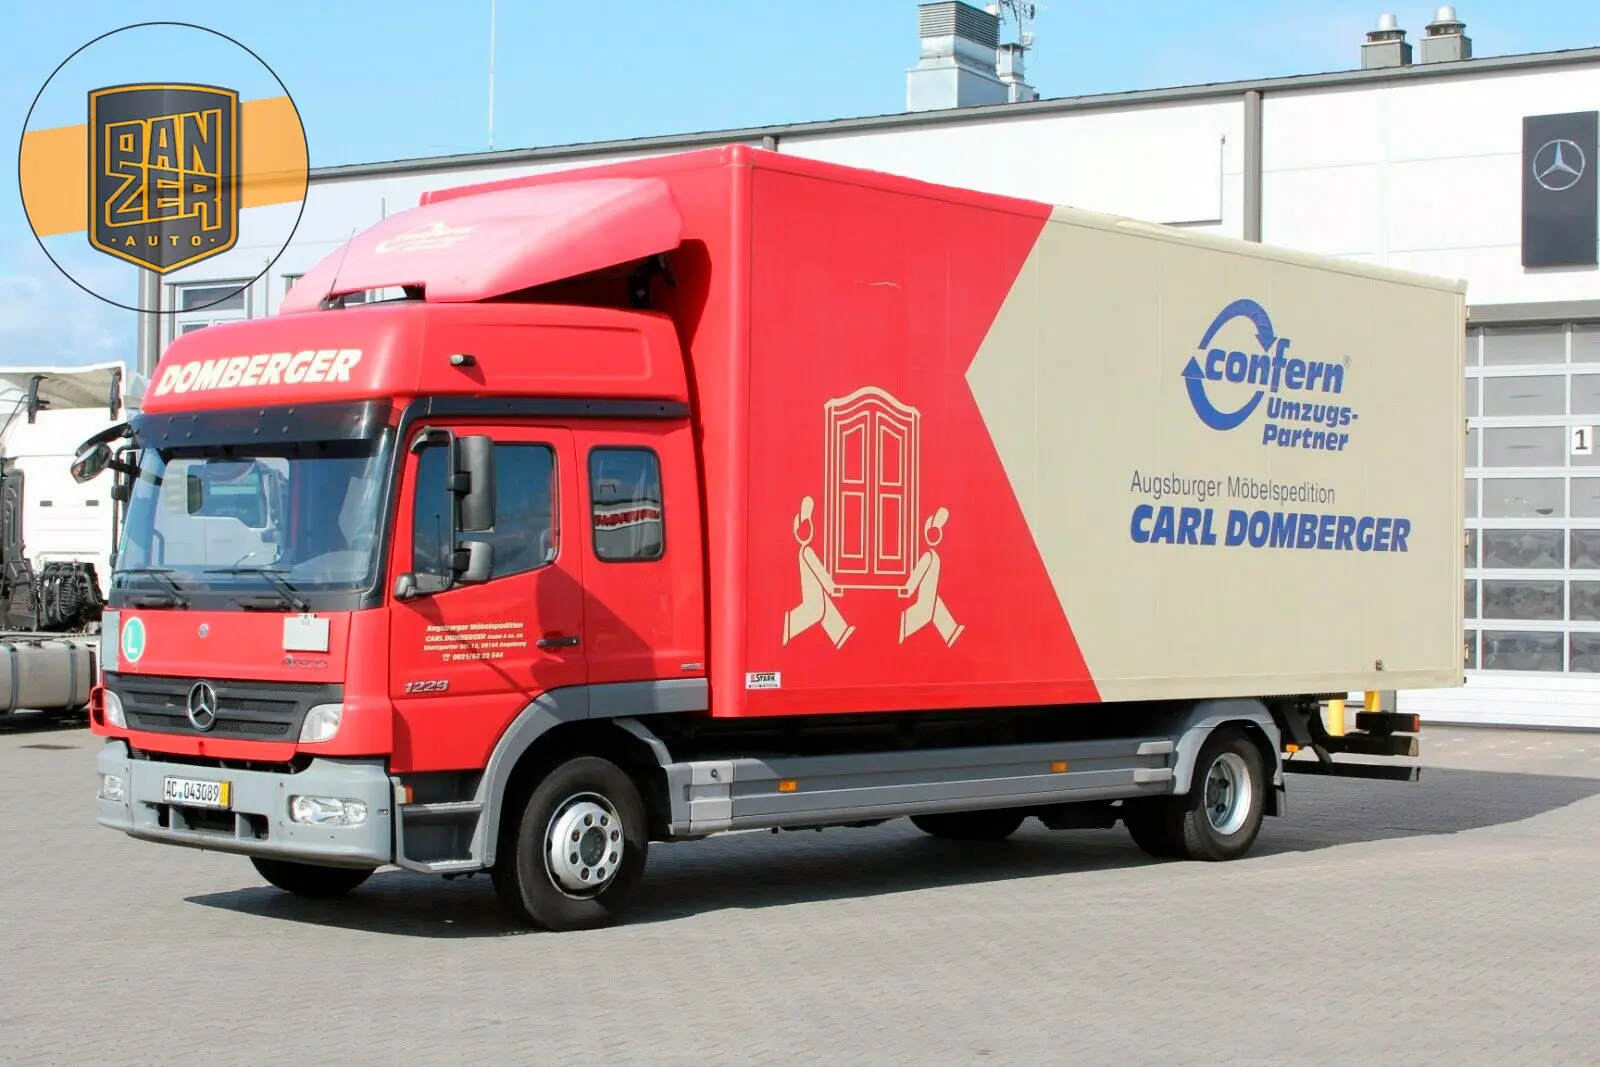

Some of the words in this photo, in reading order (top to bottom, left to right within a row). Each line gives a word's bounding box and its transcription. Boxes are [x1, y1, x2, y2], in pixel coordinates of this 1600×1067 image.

[154, 349, 363, 397] DOMBERGER
[1266, 396, 1359, 428] Umzugs-
[1262, 423, 1349, 452] Partner
[1575, 429, 1588, 450] 1
[1130, 469, 1222, 502] Augsburger
[1227, 475, 1336, 506] Möbelspedition
[1130, 504, 1217, 546] CARL
[1225, 509, 1411, 552] DOMBERGER
[128, 625, 138, 654] L
[444, 633, 487, 642] DOMBERGER
[405, 680, 449, 693] 1229
[166, 780, 177, 799] AC
[183, 782, 219, 802] 043089
